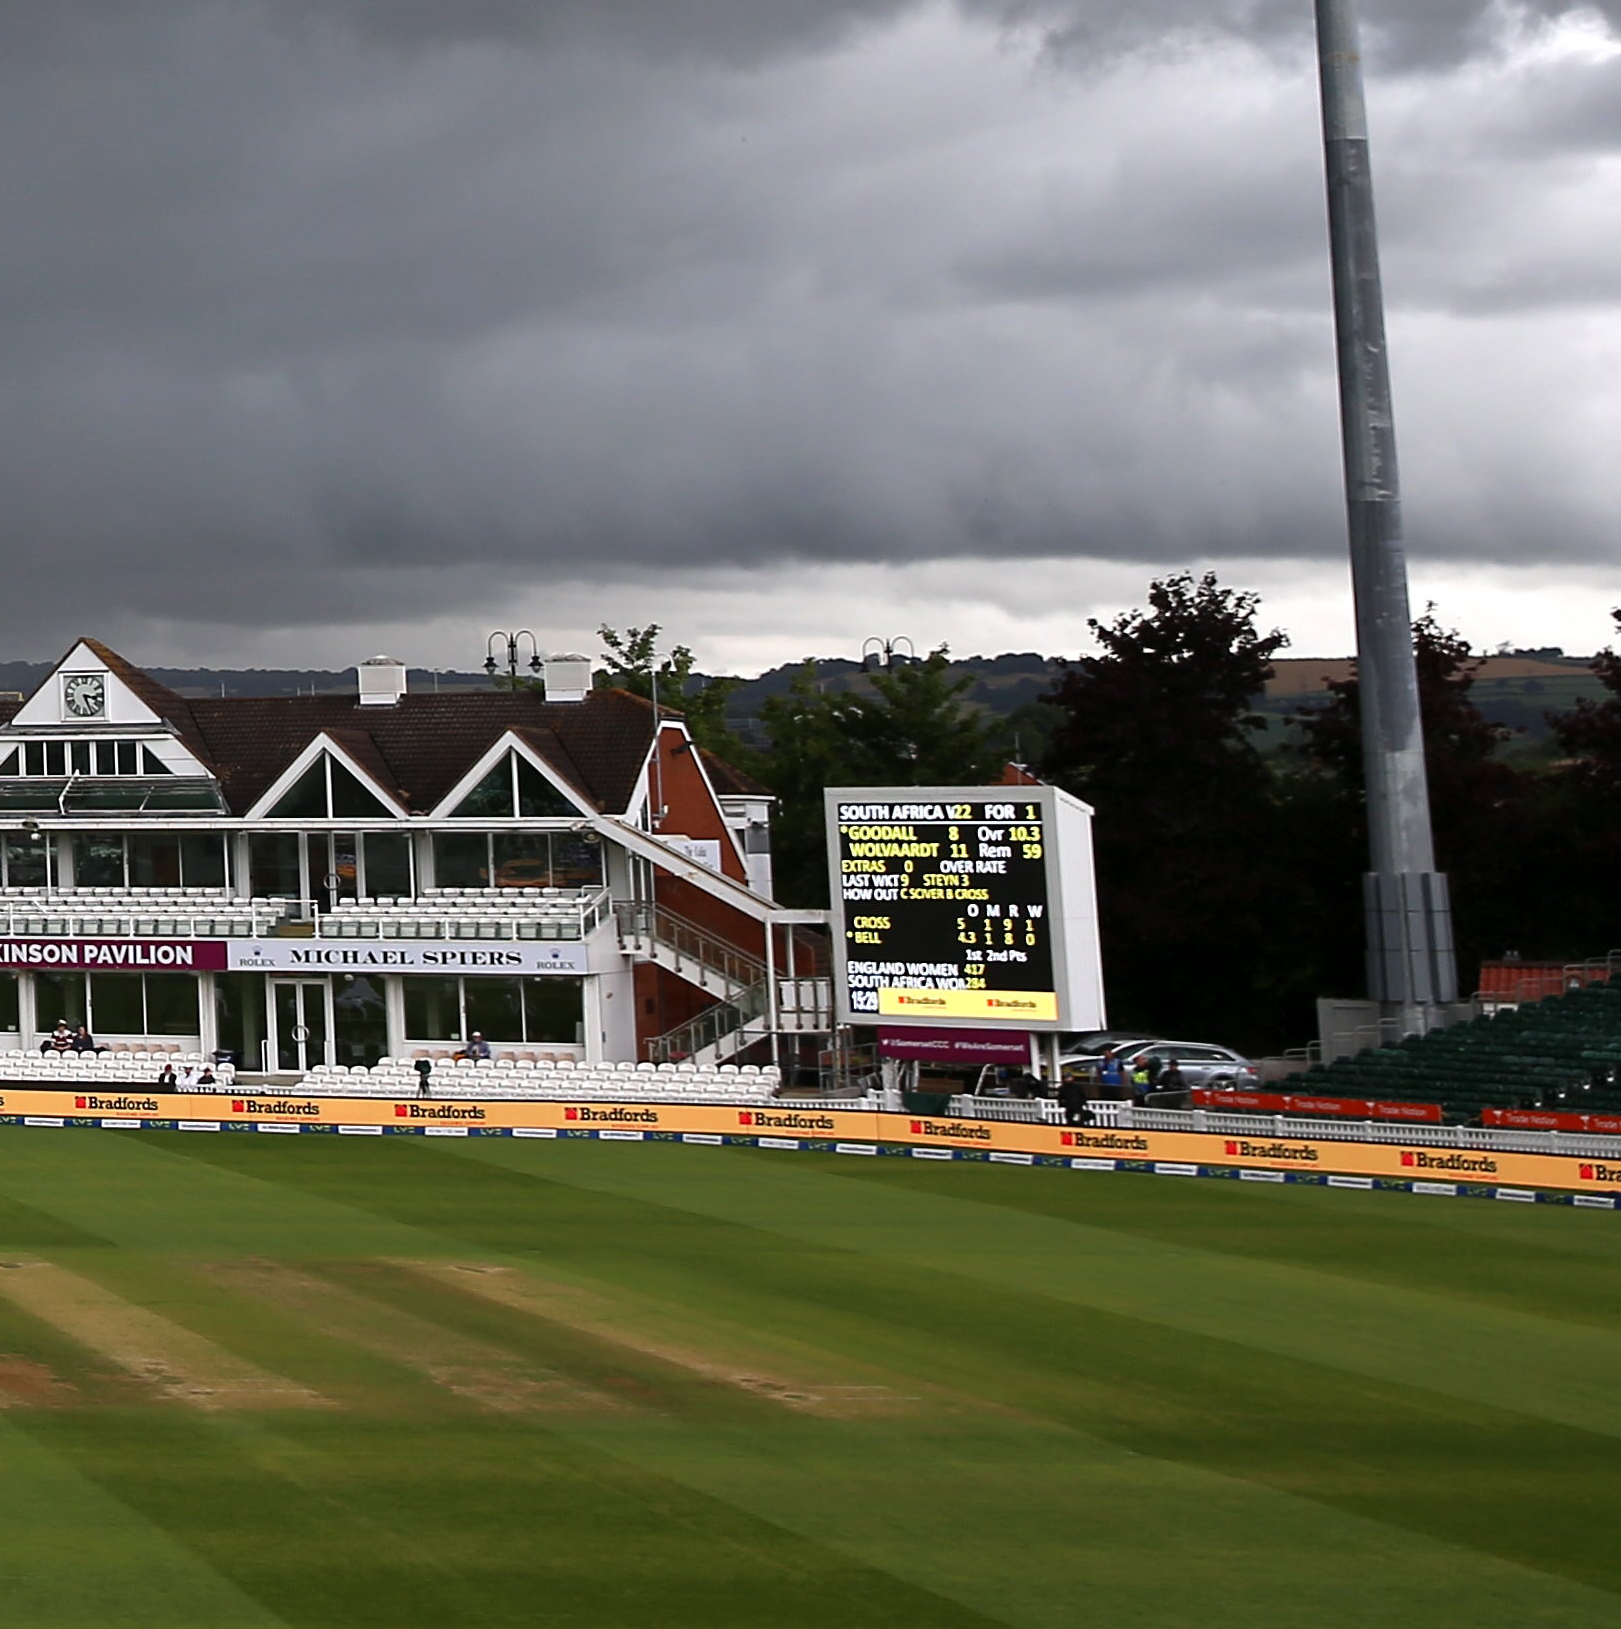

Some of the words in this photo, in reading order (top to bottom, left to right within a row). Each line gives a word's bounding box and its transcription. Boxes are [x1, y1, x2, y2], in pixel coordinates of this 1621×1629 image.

[840, 805, 889, 820] SOUTH
[892, 805, 943, 820] AFRICA
[953, 805, 972, 819] 22
[985, 805, 1015, 819] FOR
[1025, 805, 1035, 819] 1
[849, 826, 917, 841] GOODALL
[948, 827, 958, 841] 8
[978, 827, 1004, 841] Ovr
[1009, 827, 1040, 841] 10.3
[849, 843, 939, 857] WOLVAARDT
[950, 844, 968, 857] 11
[979, 844, 1011, 857] Rem
[1023, 844, 1042, 858] 59
[842, 861, 886, 872] EXTRAS
[904, 860, 913, 872] 0
[940, 861, 973, 873] OVER
[976, 861, 1007, 873] RATE
[842, 875, 869, 886] LAST
[872, 875, 899, 886] WKT
[901, 875, 909, 886] 9
[923, 875, 959, 886] STEYN
[961, 875, 969, 886] 3
[843, 889, 872, 900] HOW
[874, 889, 898, 900] OUT
[901, 889, 908, 900] C
[946, 889, 953, 900] B
[956, 889, 989, 900] CROSS
[967, 905, 979, 917] O
[987, 905, 1000, 917] M
[1009, 905, 1019, 917] R
[1027, 905, 1042, 917] W
[854, 917, 891, 929] CROSS
[957, 918, 965, 929] 5
[984, 919, 992, 931] 1
[1004, 919, 1012, 931] 9
[1026, 920, 1034, 931] 1
[855, 932, 882, 943] BELL
[984, 933, 993, 945] 1
[1004, 933, 1013, 945] 8
[1026, 933, 1035, 945] 0
[85, 944, 192, 964] PAVILION
[290, 949, 414, 965] MICHAEL
[422, 950, 522, 965] SPIERS
[966, 950, 983, 961] 1st
[987, 950, 1007, 961] 2nd
[1009, 950, 1027, 962] Pts
[239, 958, 275, 967] ROLEX
[536, 961, 574, 969] ROLEX
[848, 961, 905, 975] ENGLAND
[908, 962, 958, 976] WOMEN
[848, 976, 889, 988] SOUTH
[892, 976, 933, 989] AFRICA
[88, 1097, 159, 1111] Bradfords
[246, 1100, 320, 1115] Bradfords
[410, 1105, 486, 1120] Bradfords
[580, 1108, 658, 1123] Bradfords
[755, 1112, 834, 1129] Bradfords
[924, 1121, 991, 1140] Bradfords
[1075, 1132, 1147, 1150] Bradfords
[1240, 1141, 1319, 1161] Bradfords
[1416, 1151, 1497, 1173] Bradfords
